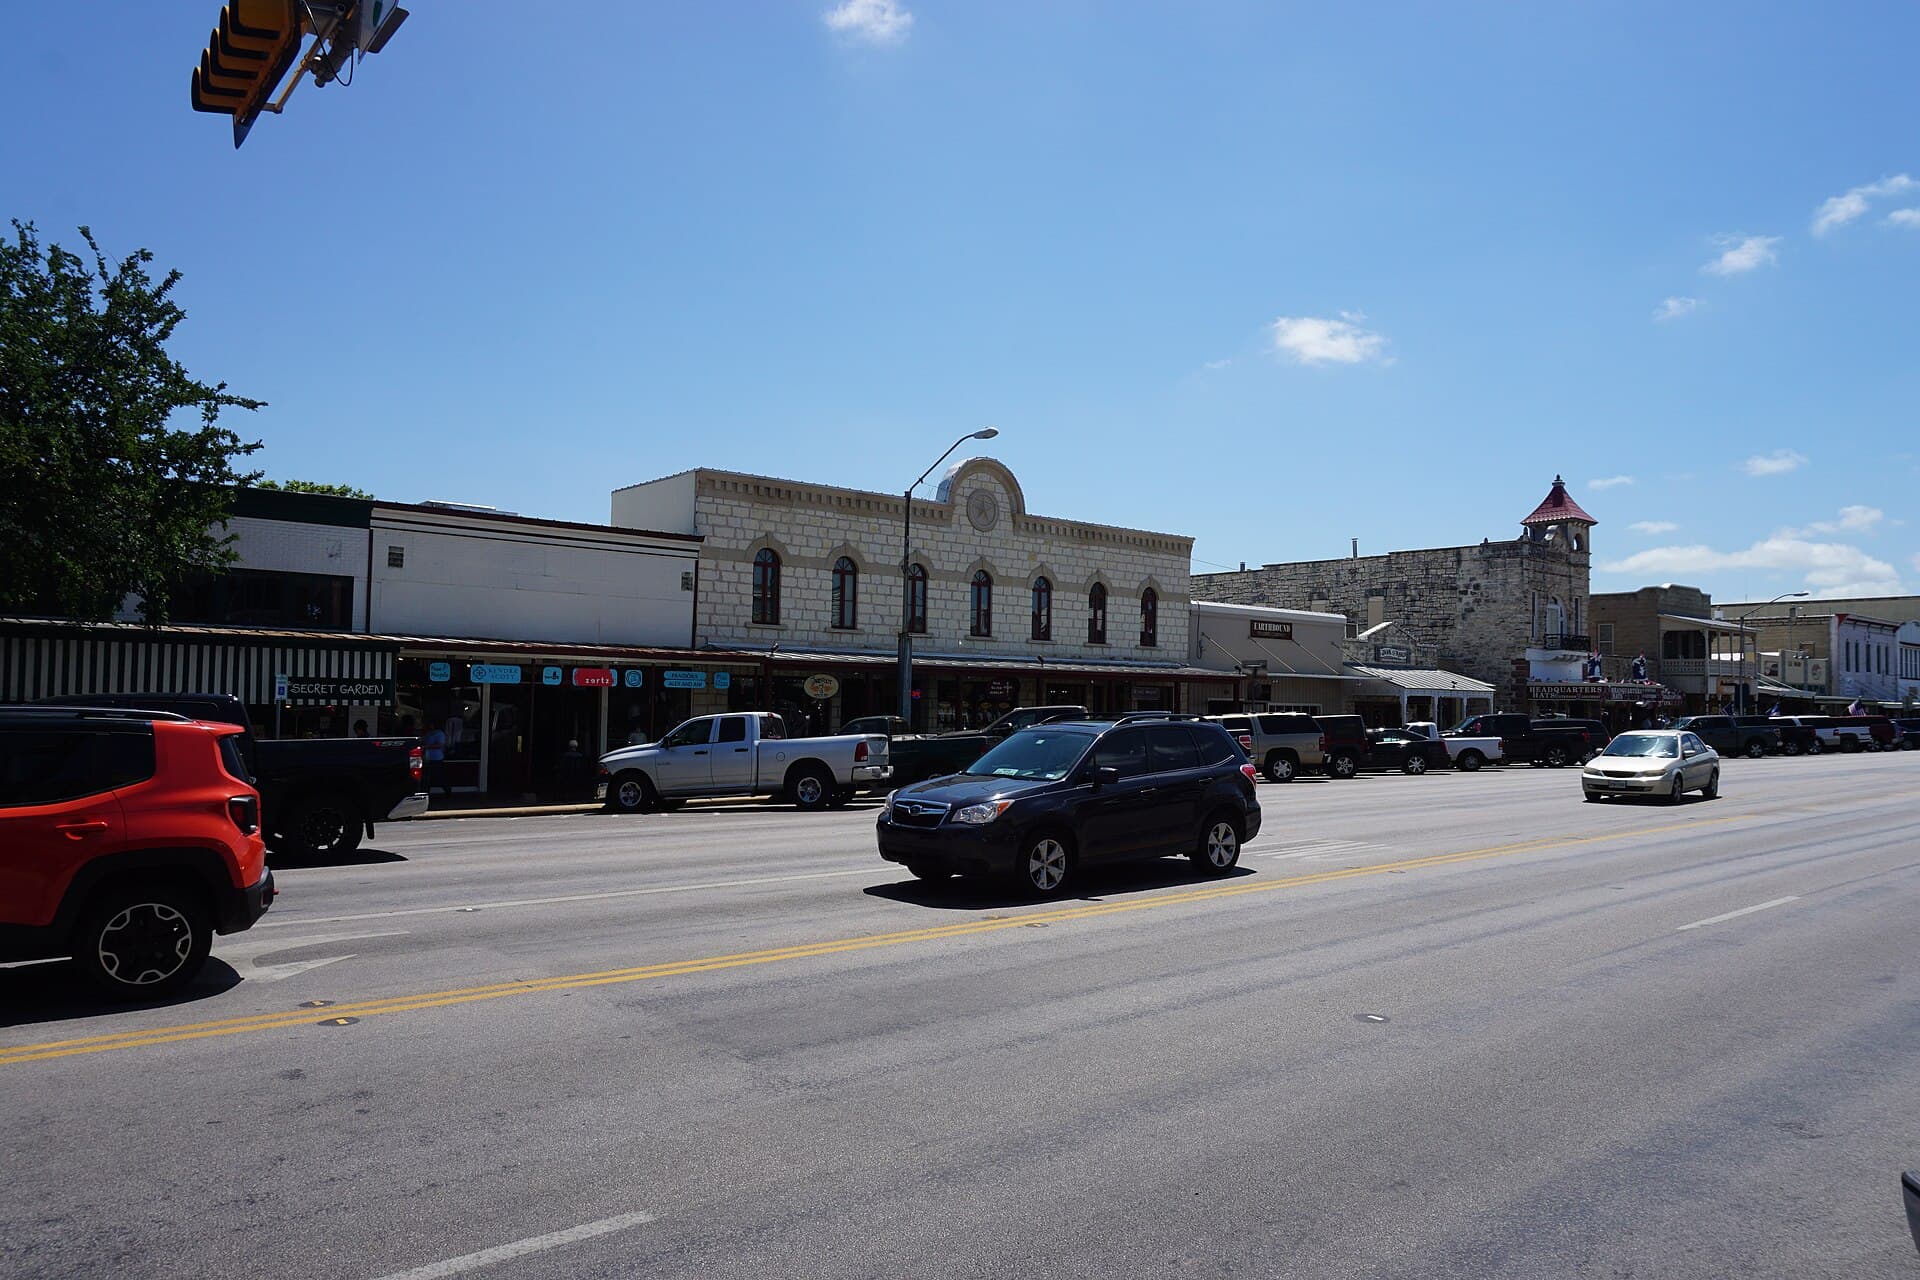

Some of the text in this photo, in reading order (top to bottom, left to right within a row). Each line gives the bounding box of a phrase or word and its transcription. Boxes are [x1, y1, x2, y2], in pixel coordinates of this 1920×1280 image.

[1253, 622, 1291, 632] EARTHBOUND
[289, 683, 337, 695] SECRET
[339, 683, 384, 695] GARDEN
[1529, 686, 1602, 694] HEADQUARTERS
